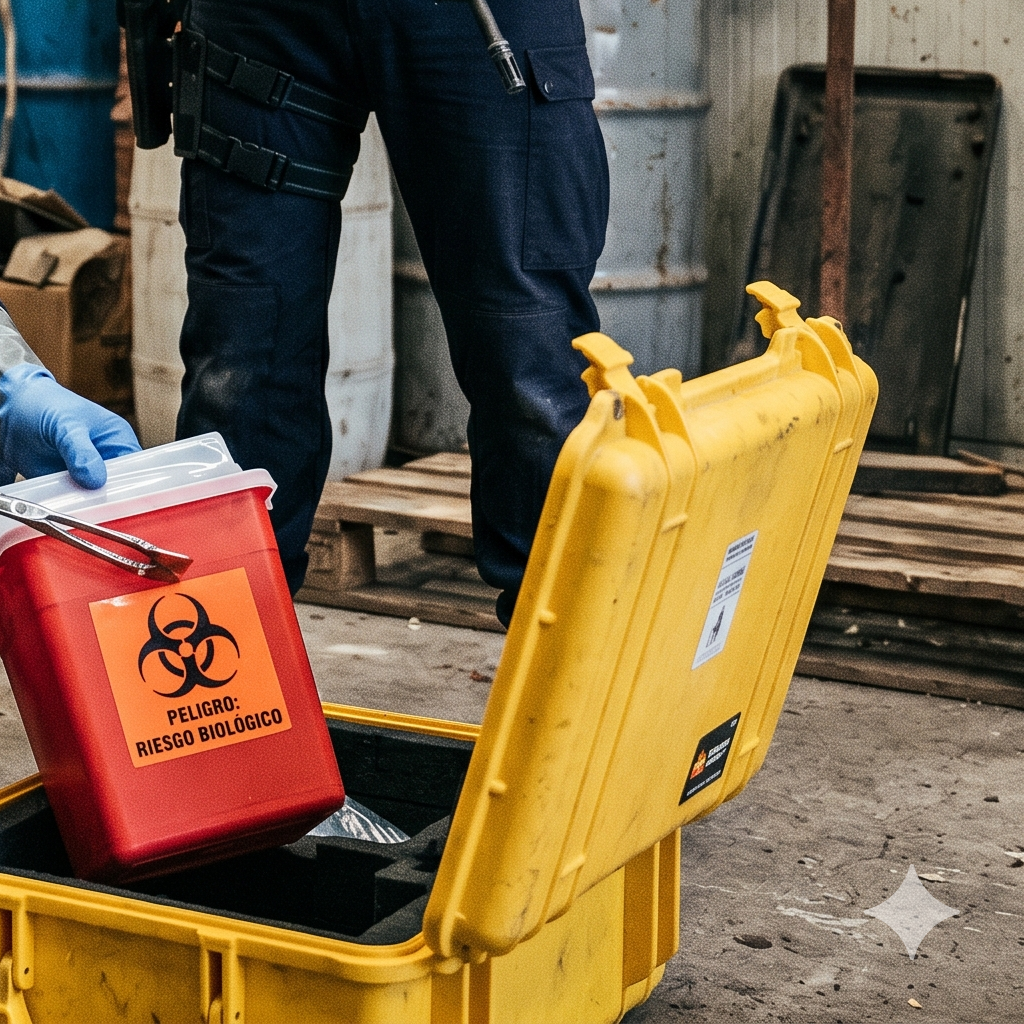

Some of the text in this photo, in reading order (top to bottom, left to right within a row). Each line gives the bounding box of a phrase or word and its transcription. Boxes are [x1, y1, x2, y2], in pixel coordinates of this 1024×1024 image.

[166, 695, 241, 726] PELIGRO:
[135, 707, 283, 758] RIESGO BIOLÓGICO
